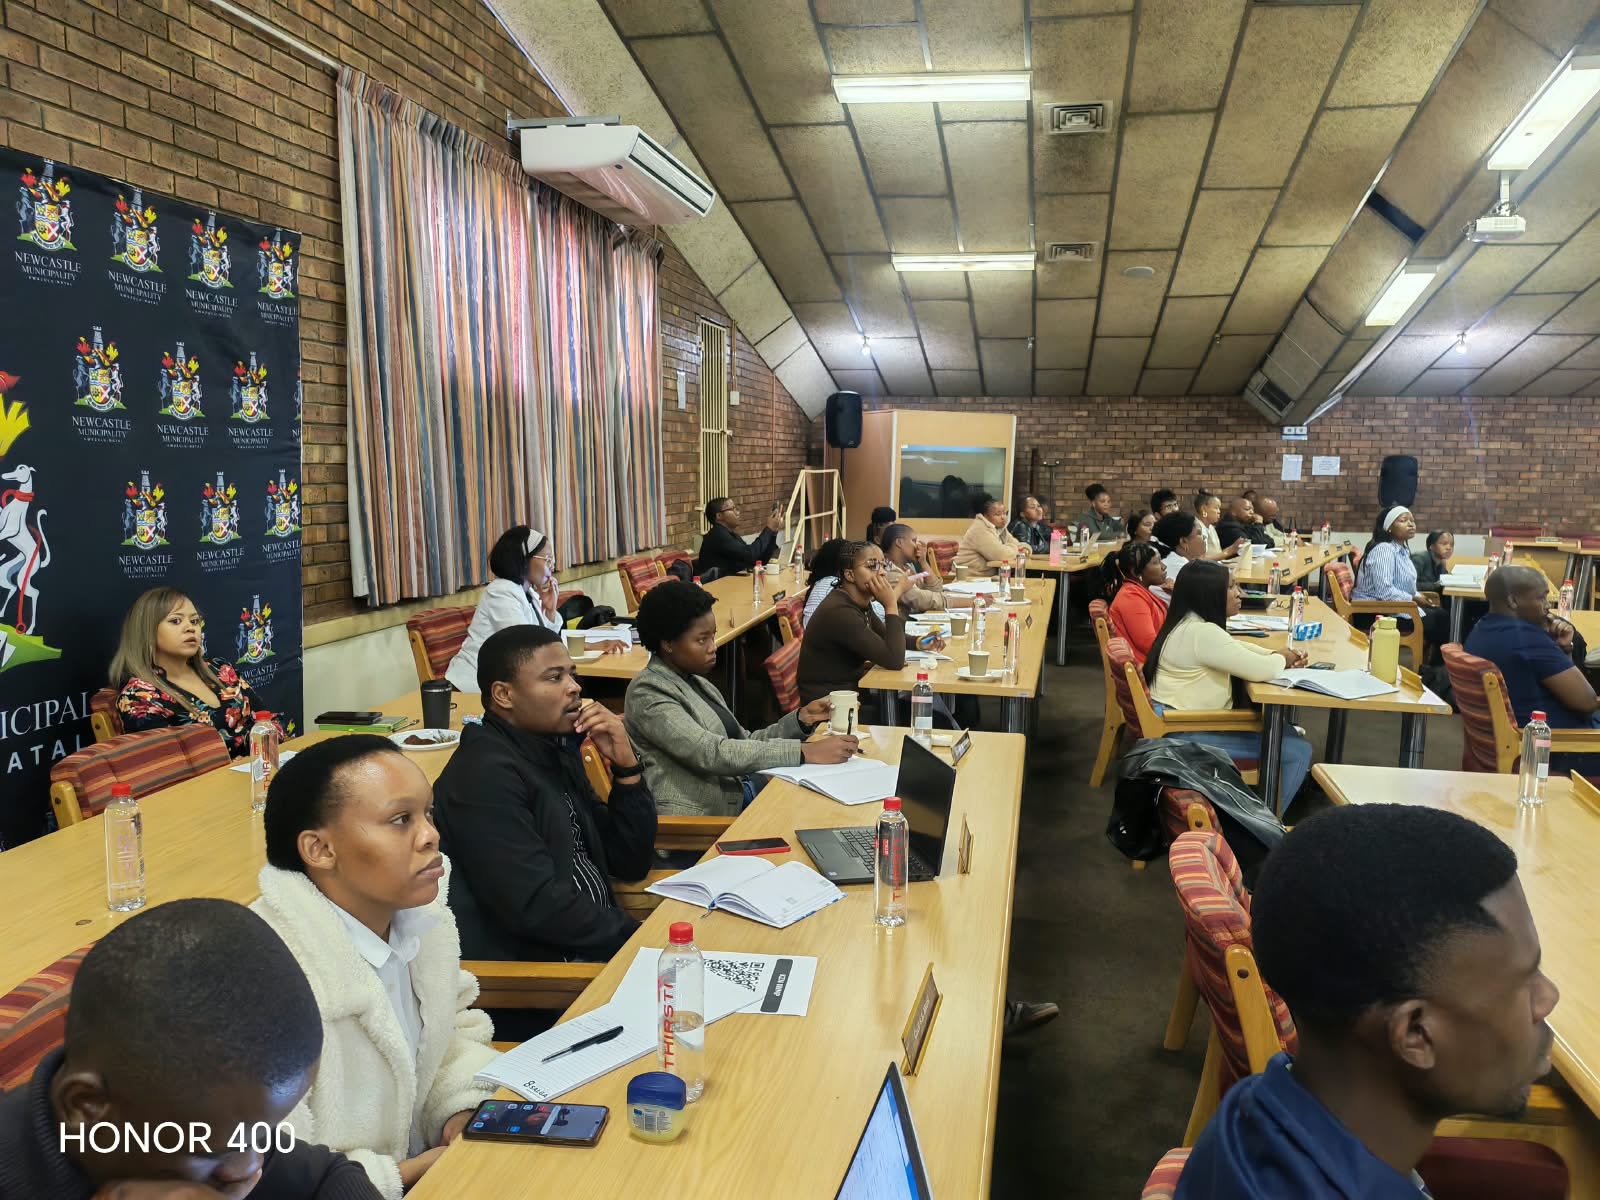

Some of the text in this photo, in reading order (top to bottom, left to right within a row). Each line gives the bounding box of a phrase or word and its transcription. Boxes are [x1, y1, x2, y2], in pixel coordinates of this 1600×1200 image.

[15, 250, 81, 272] NEWCASTLE
[21, 265, 76, 280] MUNICIPALITY
[108, 270, 167, 293] NEWCASTLE
[114, 283, 161, 301] MUNICIPALITY
[185, 288, 238, 307] NEWCASTLE
[72, 415, 131, 430] NEWCASTLE
[78, 428, 127, 438] MUNICIPALITY
[157, 424, 208, 436] NEWCASTLE
[228, 427, 273, 437] NEWCASTLE
[162, 435, 204, 443] MUNICIPALITY
[119, 554, 174, 565] NEWCASTLE
[196, 547, 244, 560] NEWCASTLE
[123, 565, 168, 574] MUNICIPALITY
[663, 983, 675, 1069] THIRSTI
